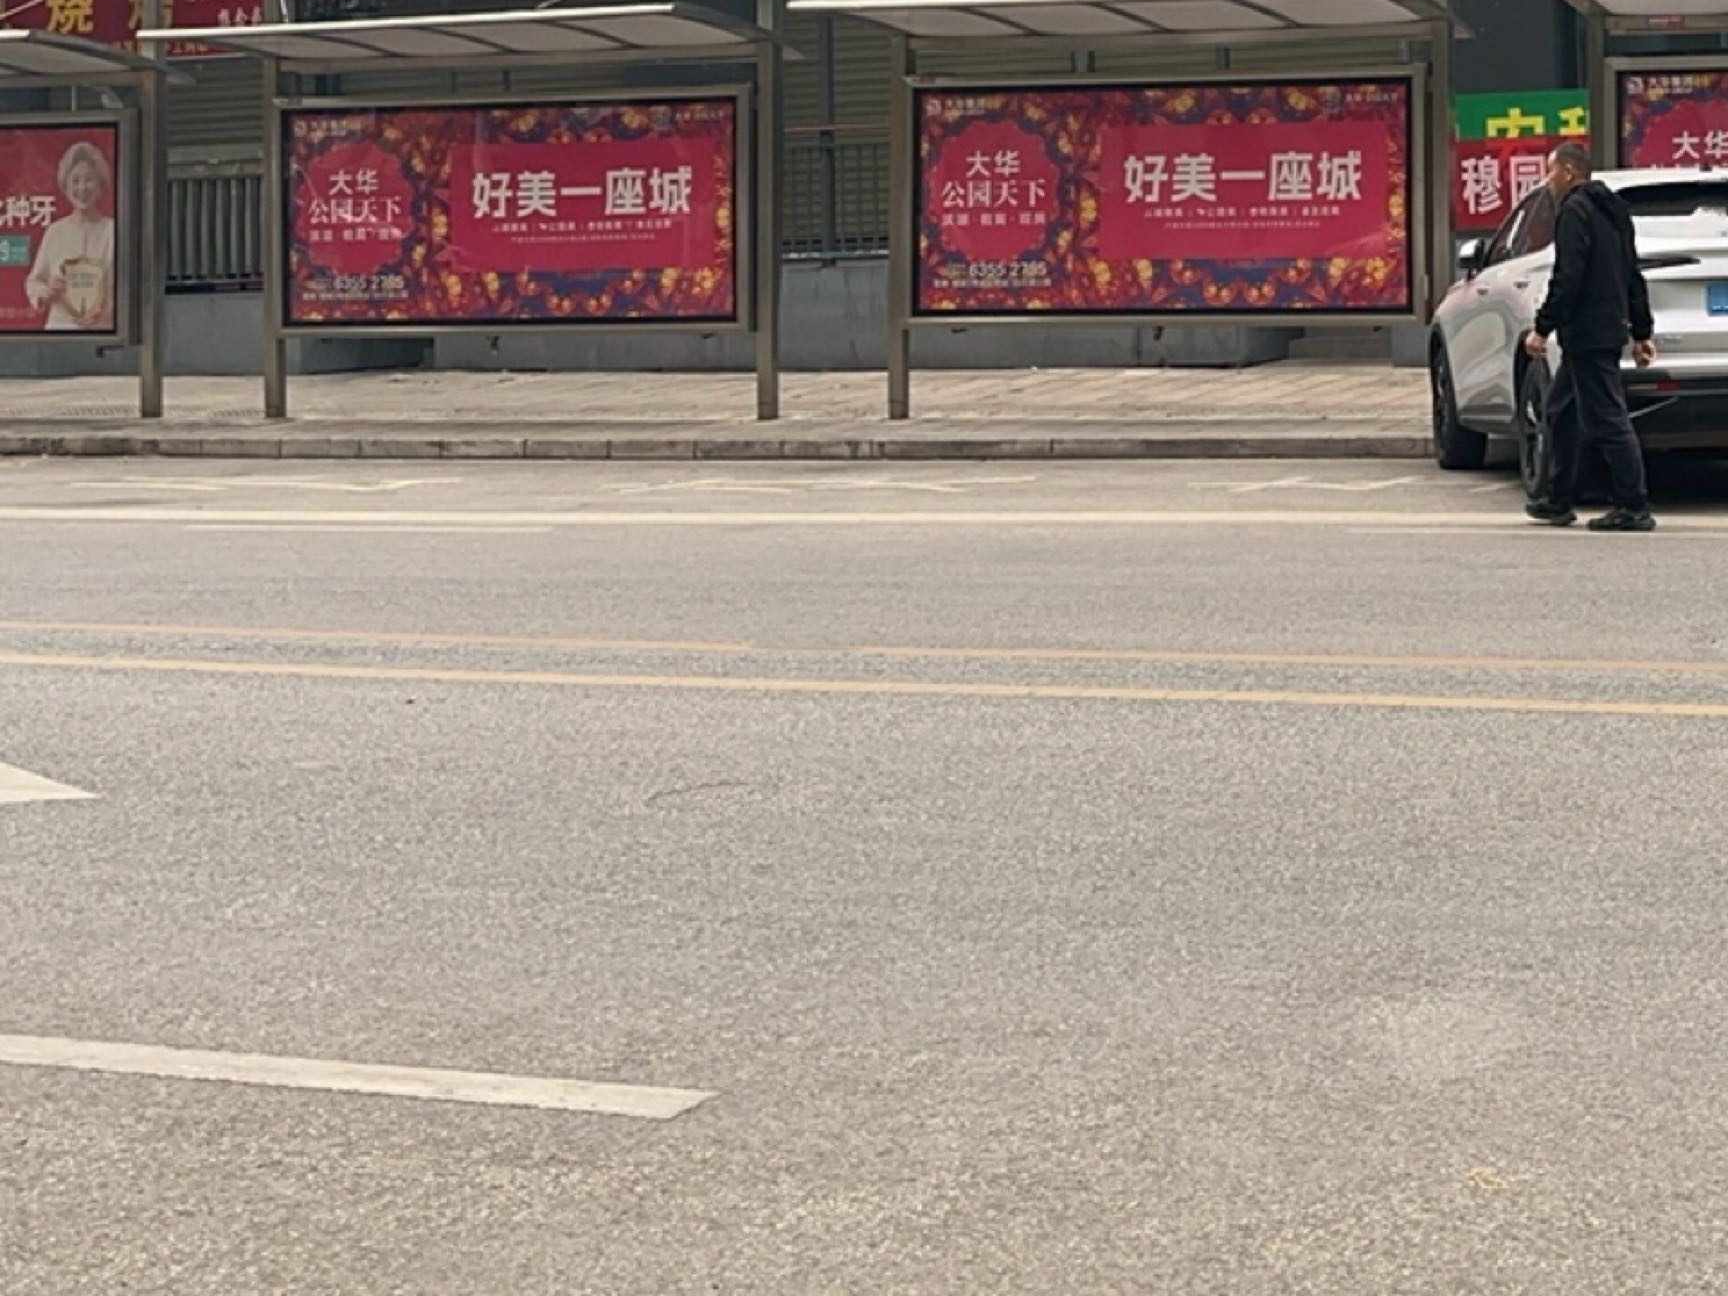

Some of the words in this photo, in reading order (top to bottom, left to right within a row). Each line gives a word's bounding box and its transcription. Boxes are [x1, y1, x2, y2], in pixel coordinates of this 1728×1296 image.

[966, 150, 1021, 178] 大华
[1123, 150, 1362, 203] 好美一座城
[329, 168, 379, 195] 大华
[473, 165, 692, 219] 好美一座城
[941, 179, 1046, 209] 公园天下
[0, 193, 56, 227] 种牙
[308, 195, 401, 225] 公园天下
